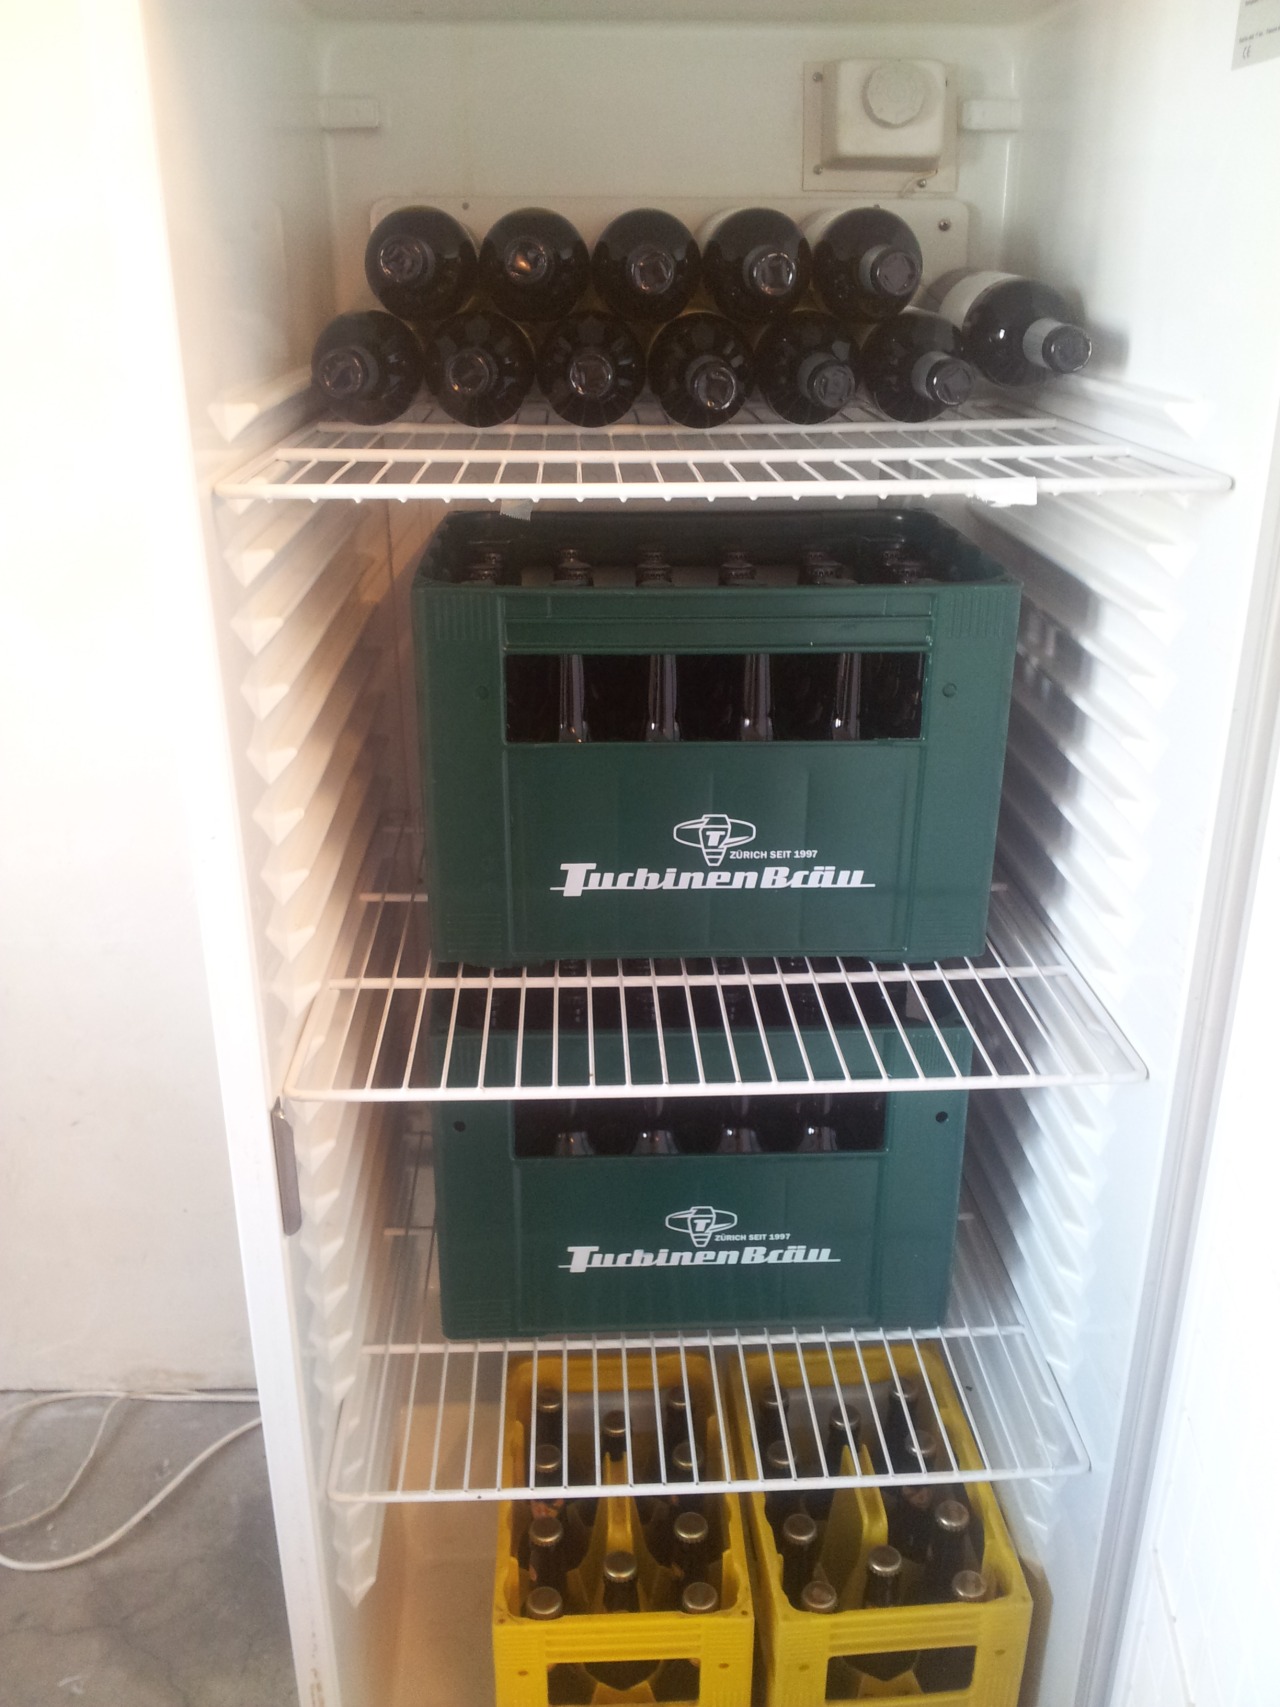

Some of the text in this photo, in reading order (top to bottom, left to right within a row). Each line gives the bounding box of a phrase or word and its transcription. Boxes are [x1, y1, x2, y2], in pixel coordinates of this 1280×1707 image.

[706, 830, 725, 846] T
[729, 849, 818, 860] ZÜRICH SEIT 1997
[550, 863, 876, 897] TurbinenBräu
[693, 1219, 711, 1232] T
[714, 1232, 791, 1242] ZÜRICH SEIT 1997
[558, 1245, 841, 1273] TurbinenBräu
